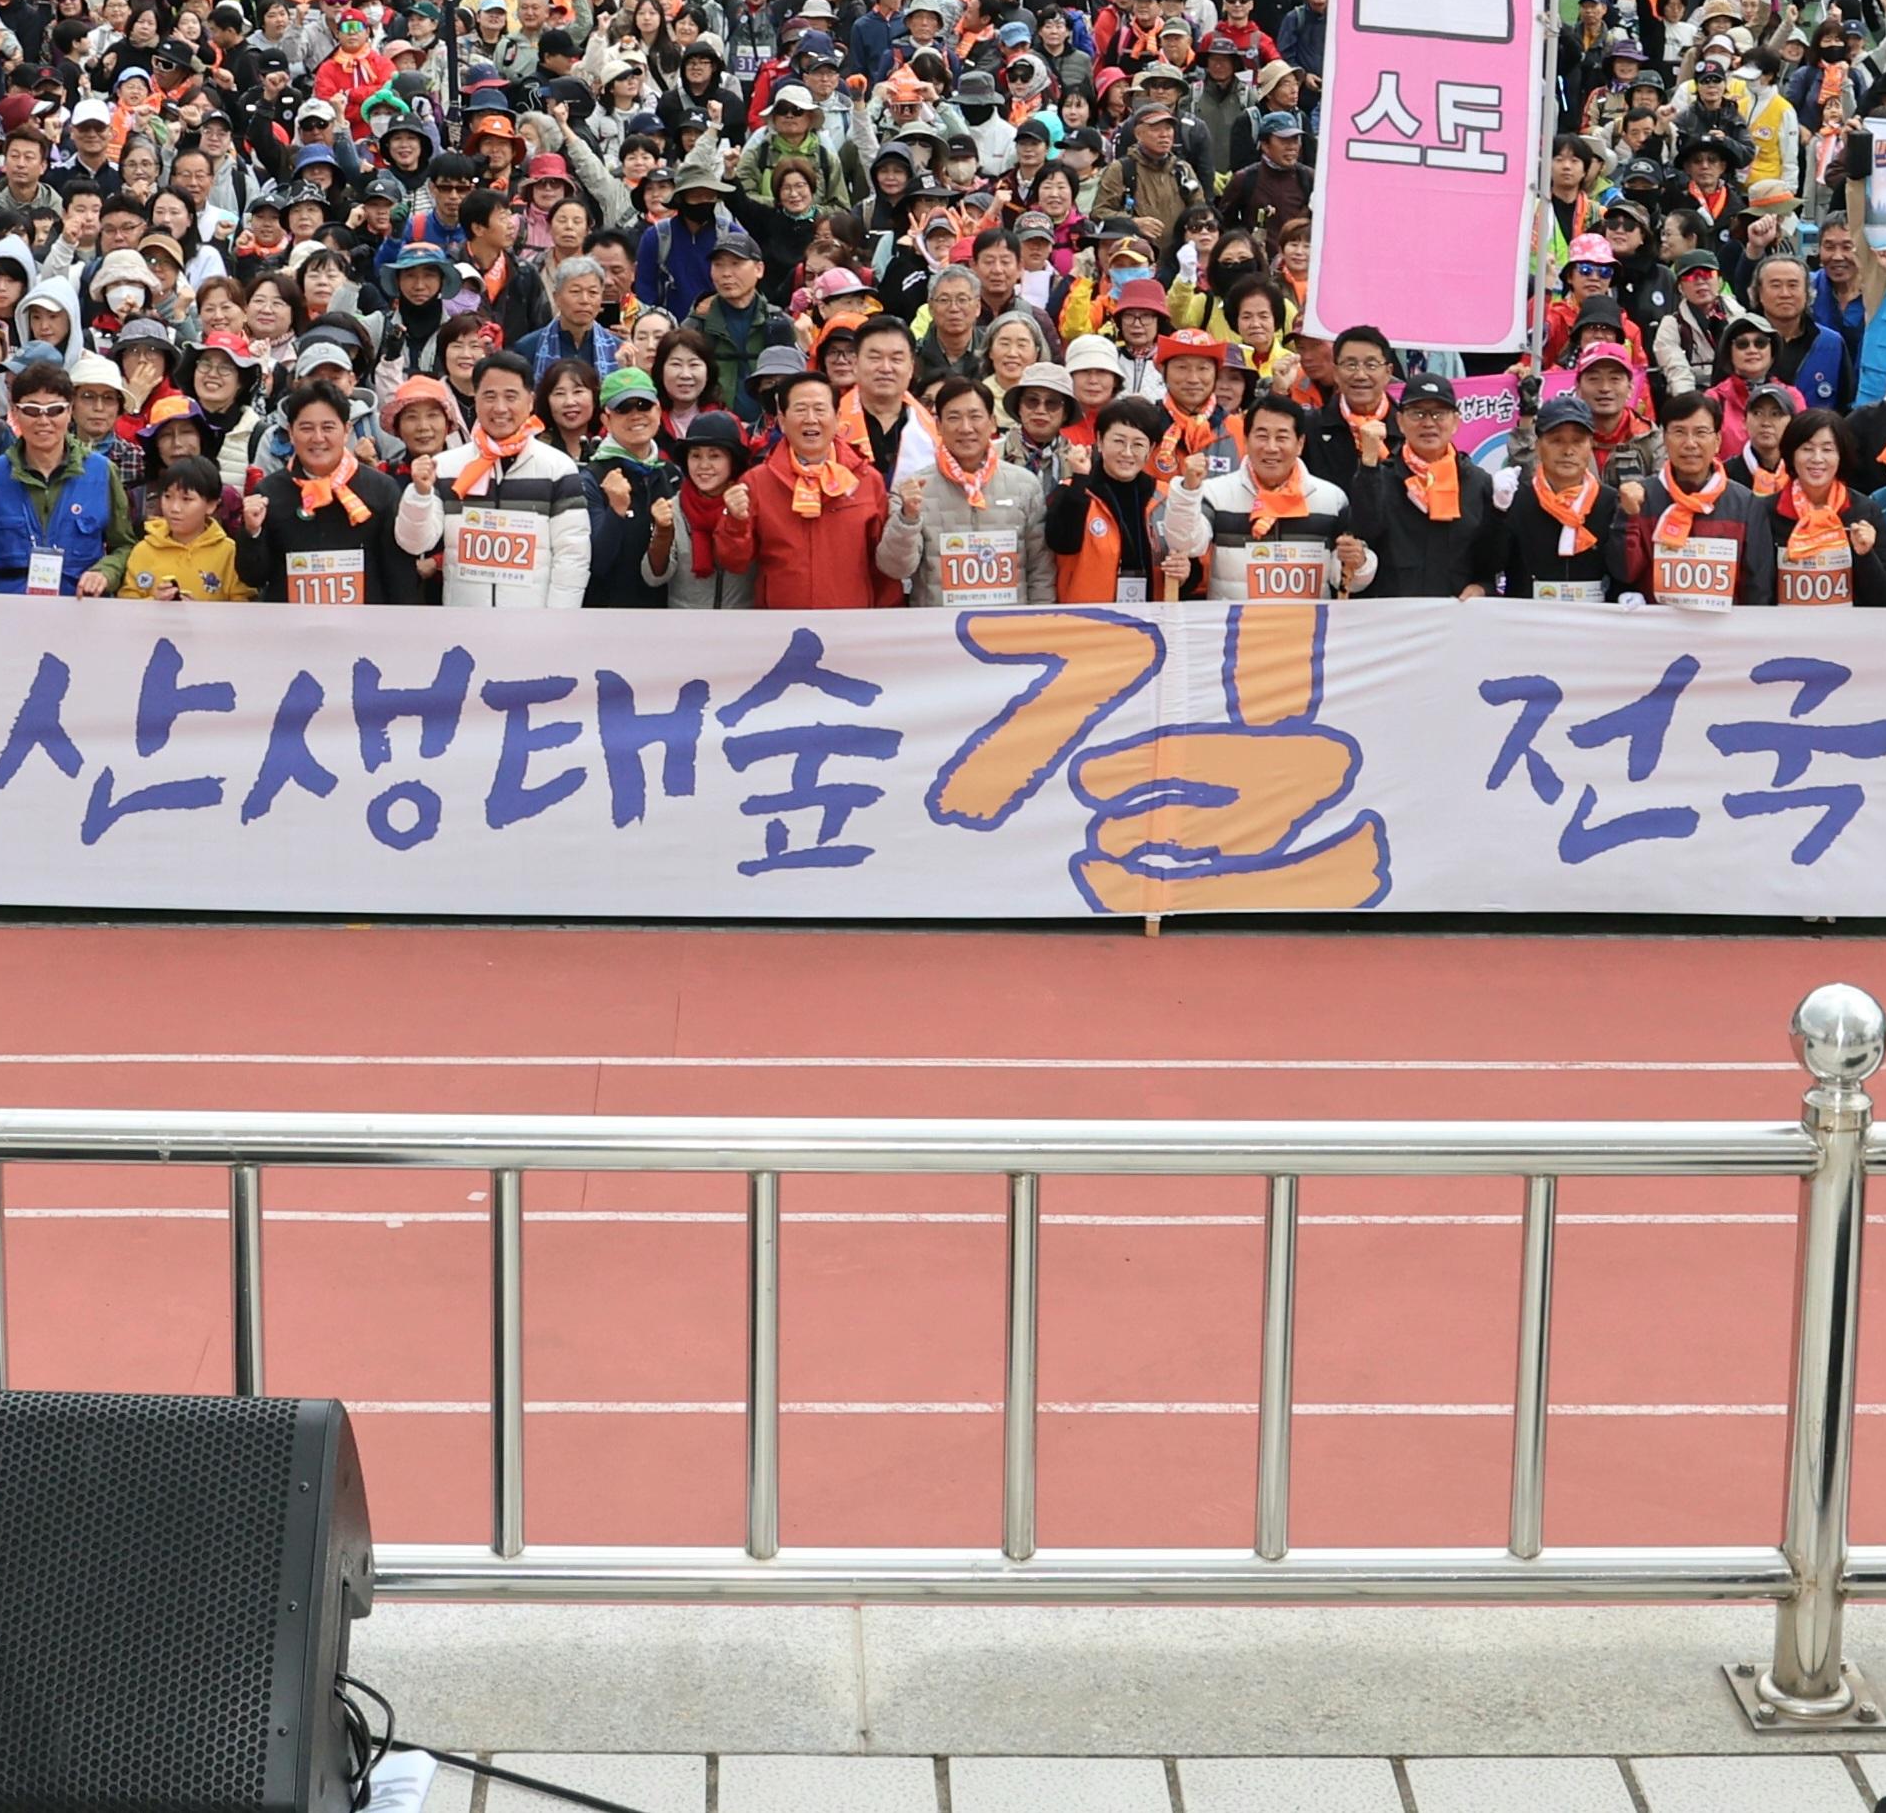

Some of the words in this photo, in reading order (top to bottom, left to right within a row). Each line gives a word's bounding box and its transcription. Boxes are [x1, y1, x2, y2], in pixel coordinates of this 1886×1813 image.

[463, 532, 530, 566] 1002
[947, 555, 1014, 586] 1003
[1254, 566, 1316, 595] 1001
[1660, 562, 1730, 592] 1005
[295, 575, 356, 604] 1115
[1782, 573, 1849, 602] 1004
[925, 603, 1390, 915] 길
